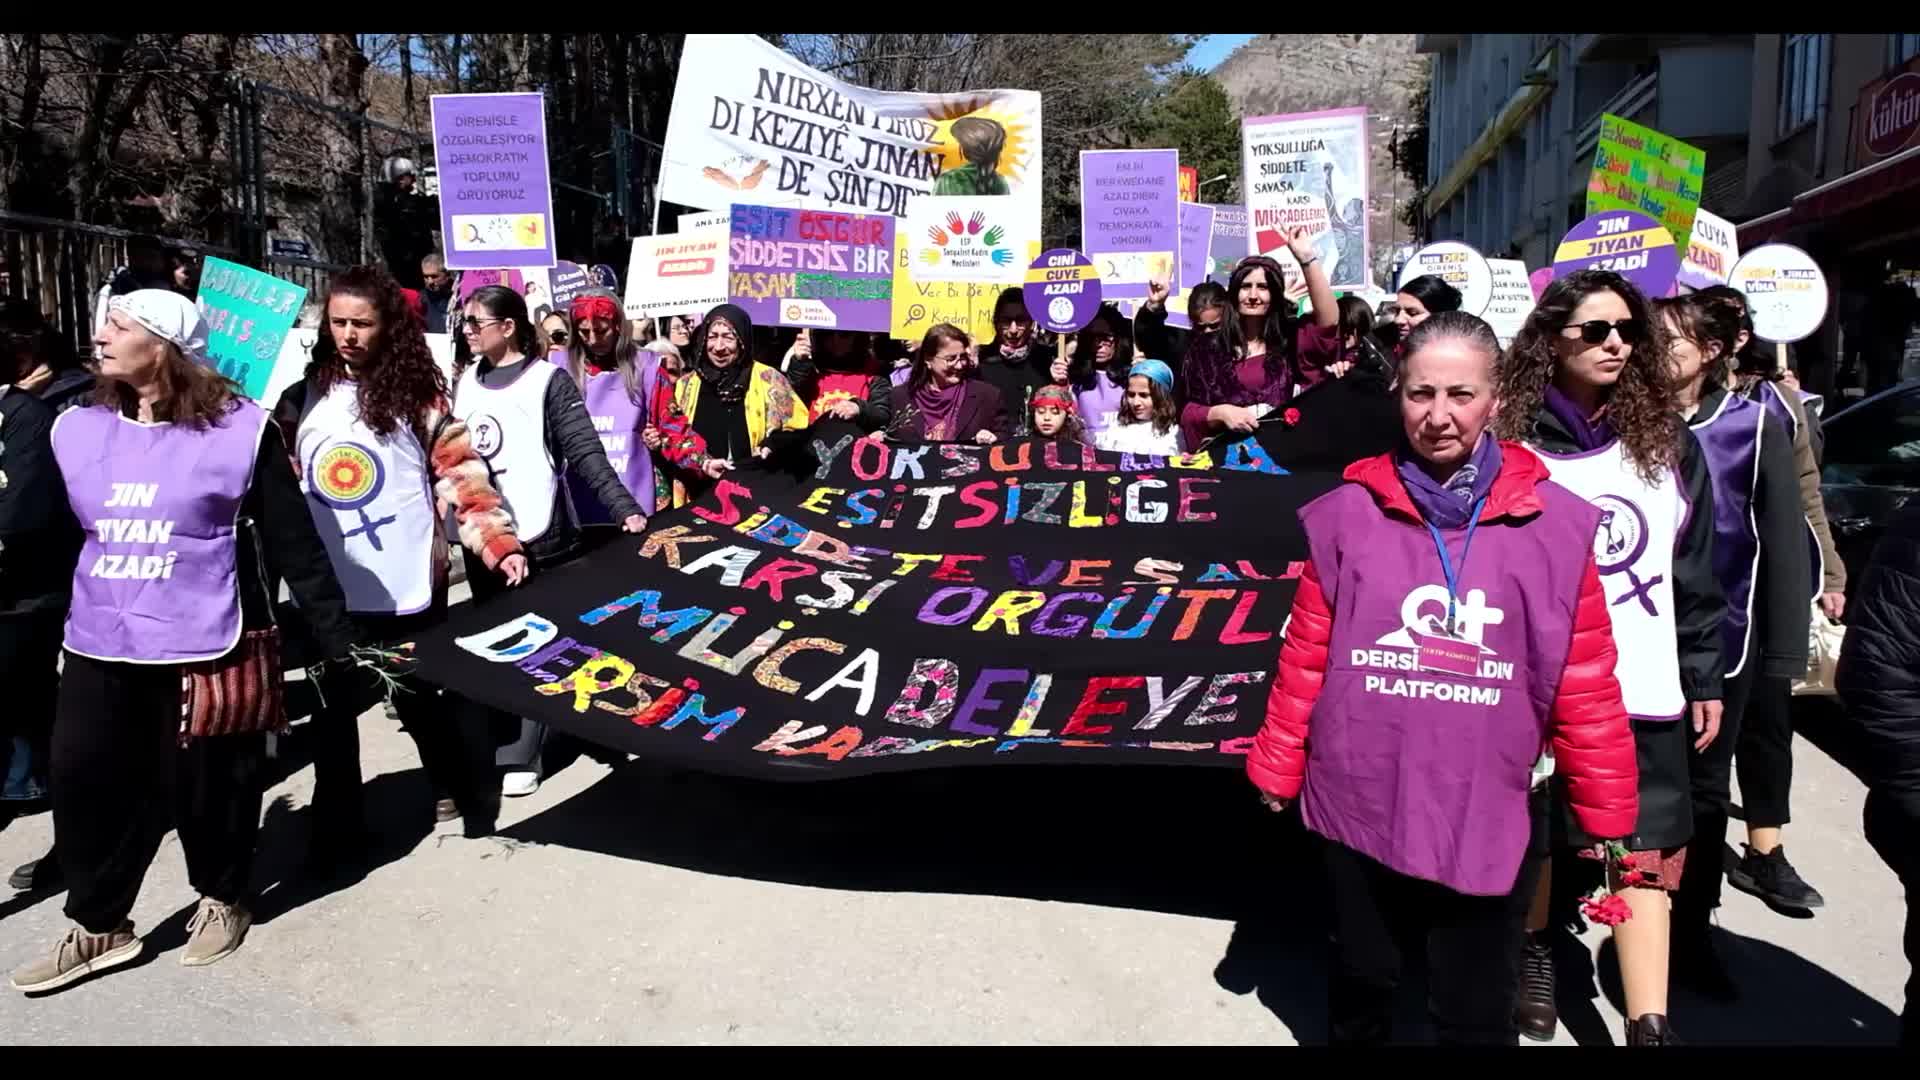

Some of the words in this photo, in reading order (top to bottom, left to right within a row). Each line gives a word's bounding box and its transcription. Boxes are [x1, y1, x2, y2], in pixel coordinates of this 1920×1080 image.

[710, 96, 745, 136] DI
[749, 106, 850, 164] KEZIYÊ
[856, 135, 947, 182] JINAN
[1251, 137, 1326, 157] YOKSULLUĞA
[463, 171, 520, 183] TOPLUMU
[777, 155, 815, 196] DE
[1260, 160, 1309, 178] ŞİDDETE
[1103, 191, 1130, 201] AZAD
[1254, 181, 1295, 195] SAVAŞA
[1596, 216, 1630, 236] JIN
[1696, 220, 1729, 249] CUYA
[943, 248, 970, 257] Sosyalist
[960, 238, 972, 246] ESP
[1587, 235, 1645, 256] JIYAN
[854, 244, 892, 274] BİR
[951, 259, 981, 268] Meclisleri
[1046, 269, 1080, 281] CUYE
[729, 272, 796, 304] YAŞAM
[104, 482, 160, 507] JIN
[638, 525, 898, 616] KARŞI
[1008, 555, 1112, 587] VE
[1122, 556, 1304, 585] SAV
[578, 589, 1266, 738] MÜCADELEYE
[1351, 648, 1425, 672] DERSİ
[1476, 659, 1514, 680] DIN
[454, 612, 747, 741] DERSİM
[753, 719, 994, 761] KAD
[1365, 675, 1501, 706] PLATFORMU
